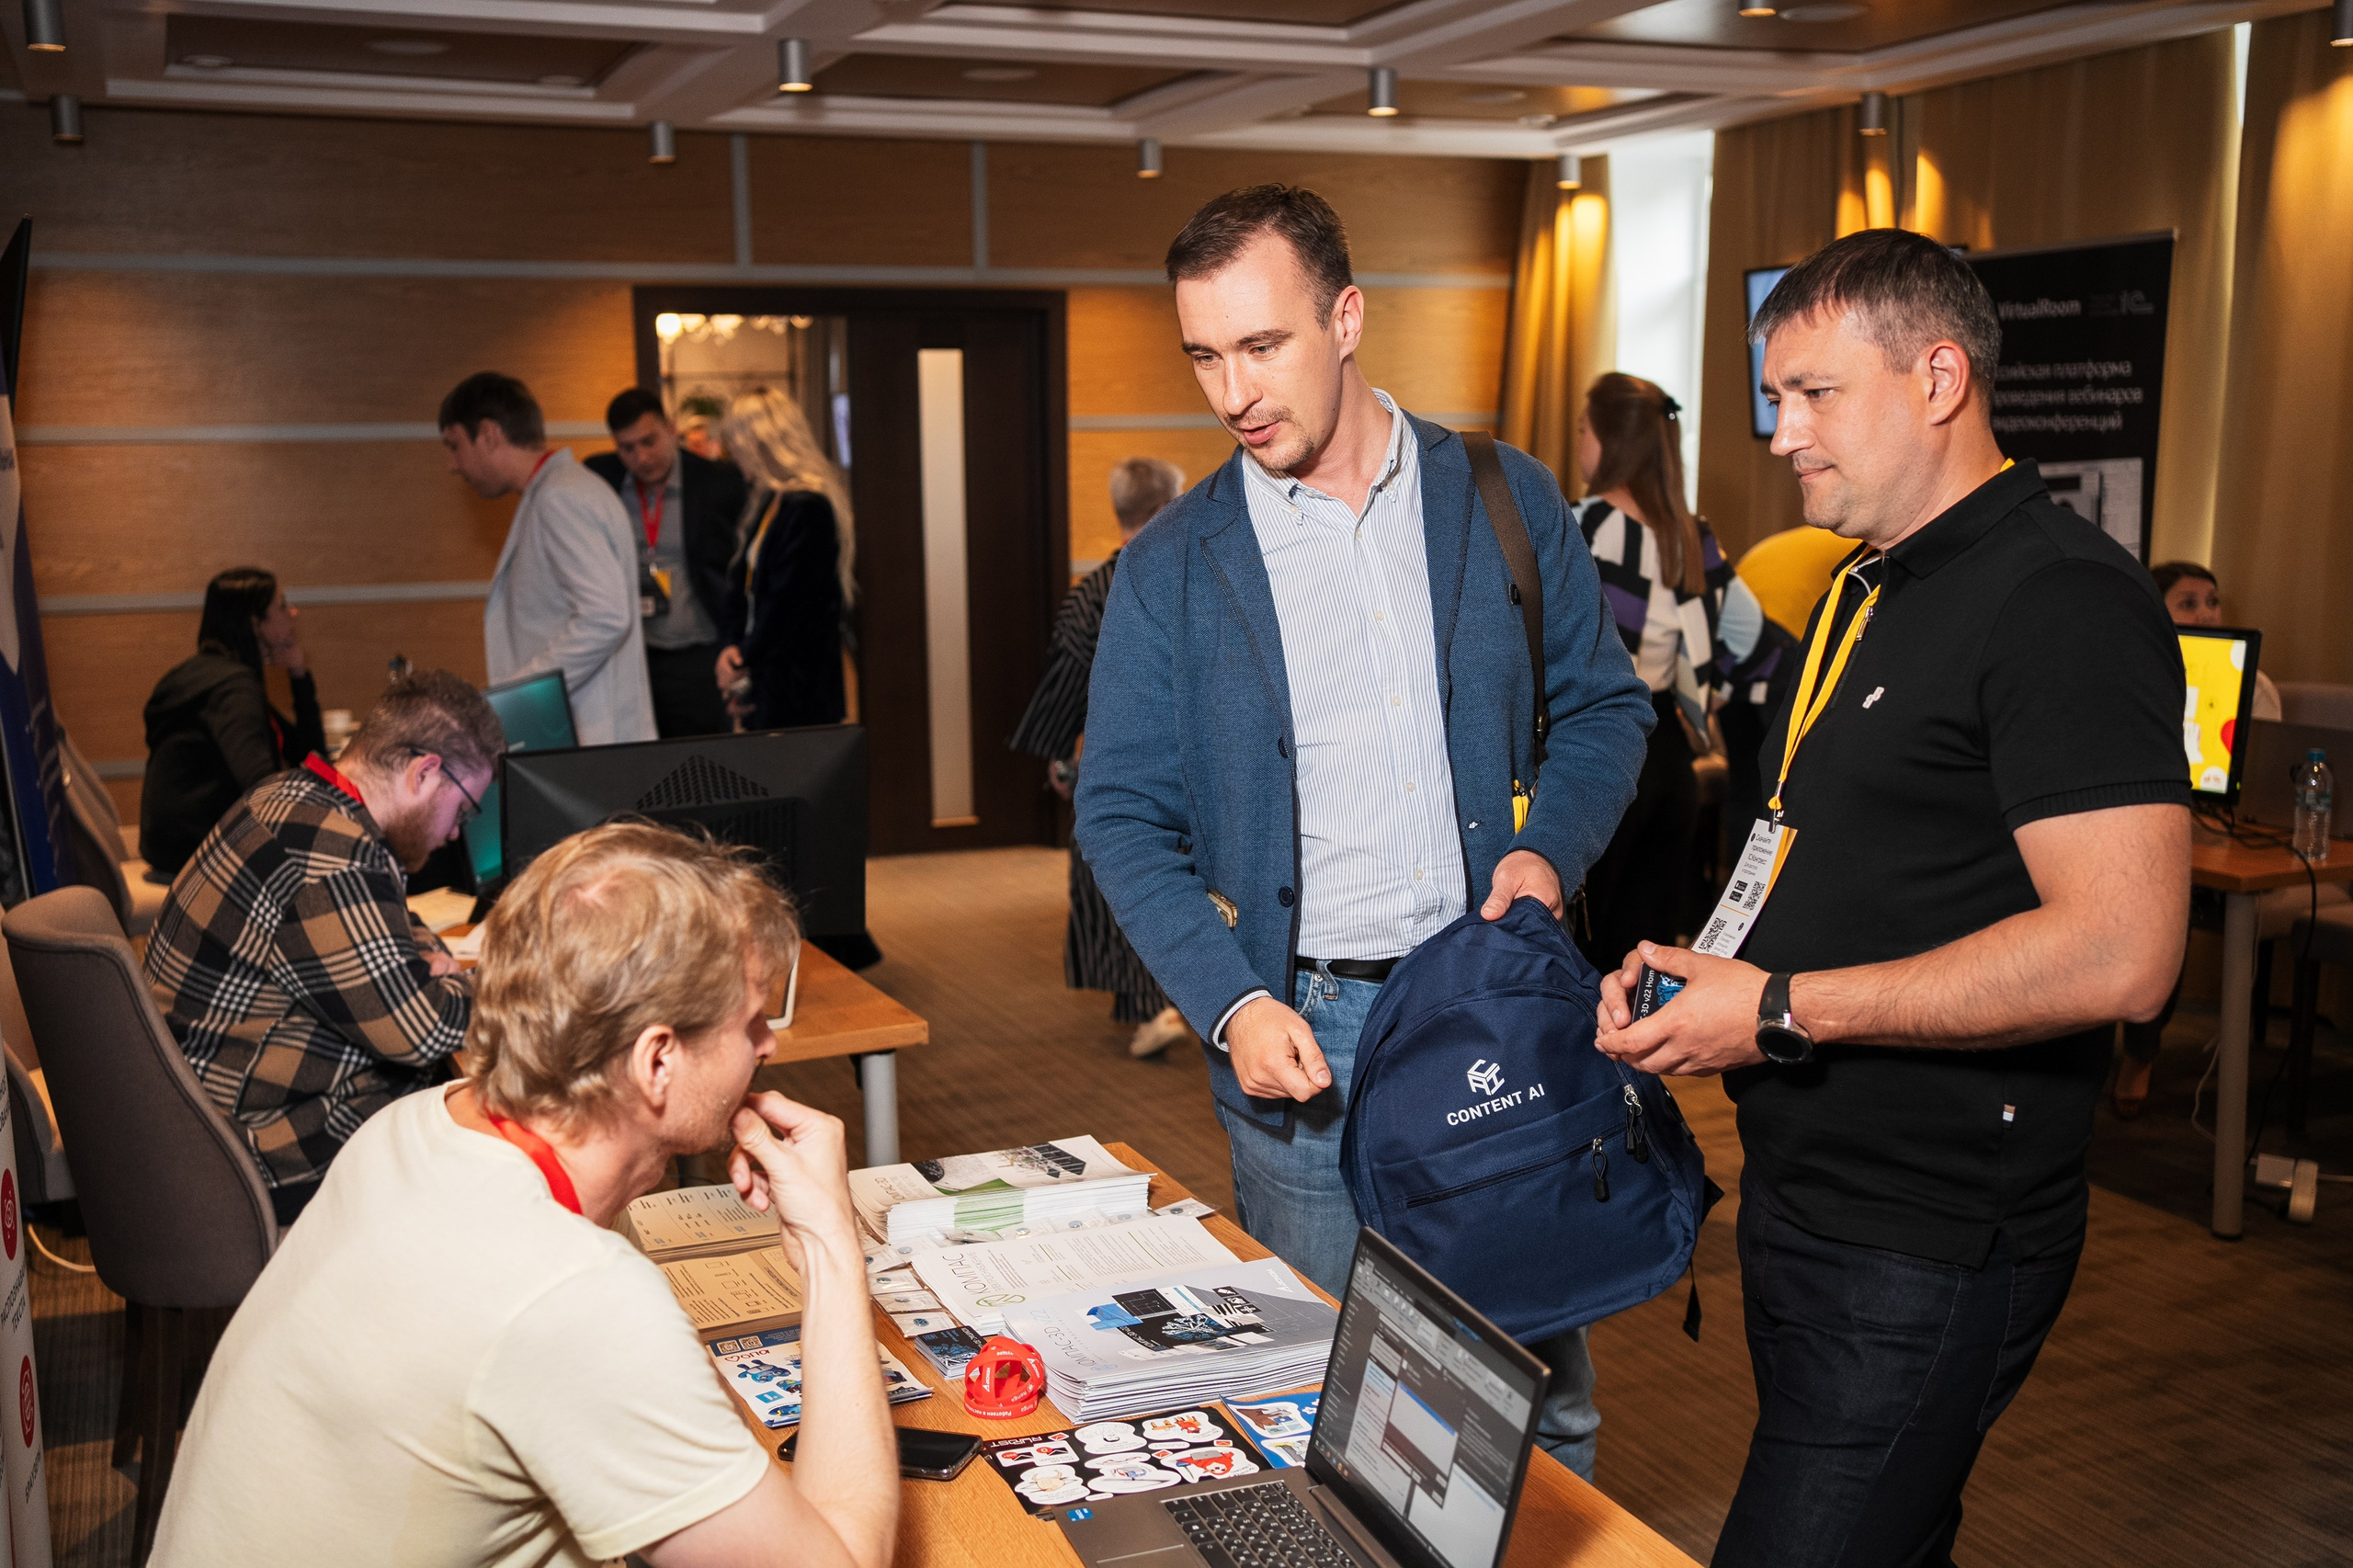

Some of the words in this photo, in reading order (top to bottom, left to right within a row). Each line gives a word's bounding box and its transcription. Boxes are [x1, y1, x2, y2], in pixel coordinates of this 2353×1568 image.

[1995, 389, 2066, 408] роведения
[2068, 384, 2144, 408] вебинаров
[1646, 969, 1655, 986] Hom
[1447, 1090, 1522, 1126] CONTENT
[1529, 1083, 1545, 1100] AI
[942, 1253, 991, 1295] КОМПАС
